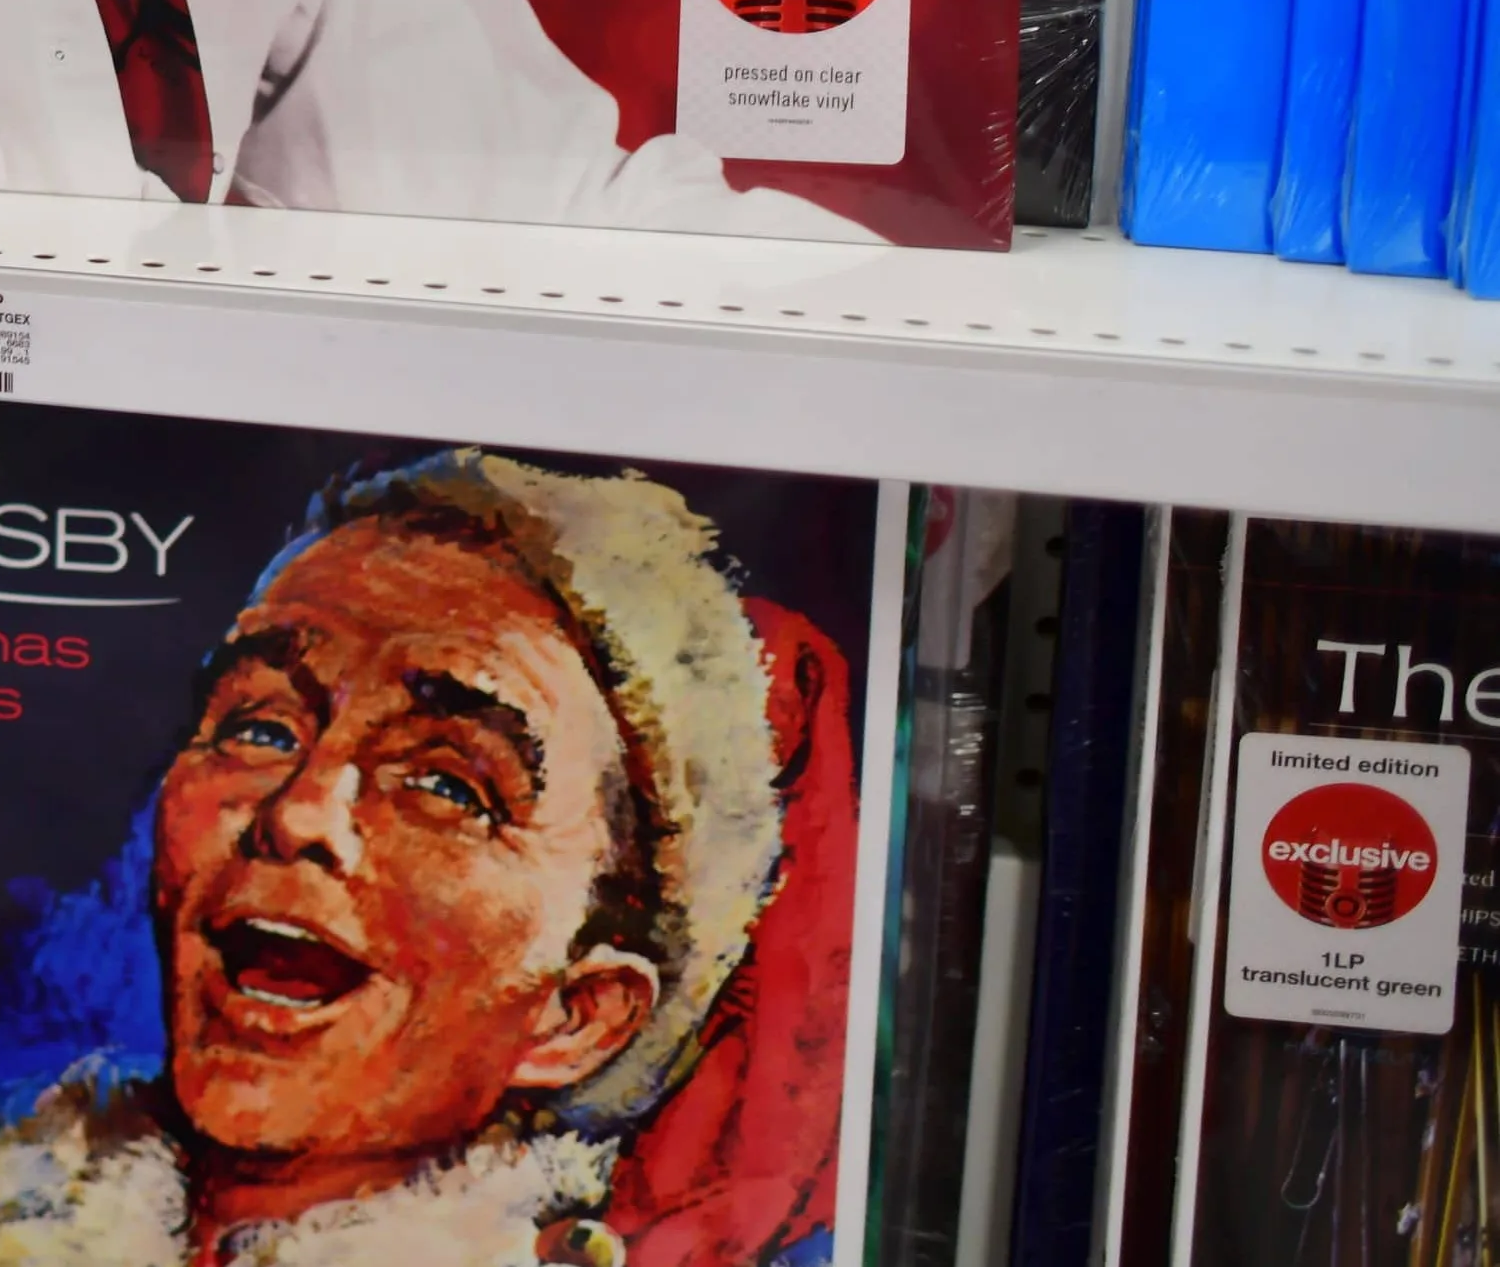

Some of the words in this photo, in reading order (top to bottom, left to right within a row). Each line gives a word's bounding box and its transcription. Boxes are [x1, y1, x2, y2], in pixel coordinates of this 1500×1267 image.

[724, 64, 788, 83] pressed
[794, 69, 813, 83] on
[819, 65, 863, 84] clear
[728, 89, 810, 108] snowflake
[816, 93, 855, 111] vinyl
[1271, 750, 1350, 772] limited
[1358, 757, 1440, 778] edition
[1268, 837, 1431, 872] exclusive
[1321, 951, 1365, 970] 1LP
[1241, 965, 1370, 991] translucent
[1376, 981, 1442, 998] green
